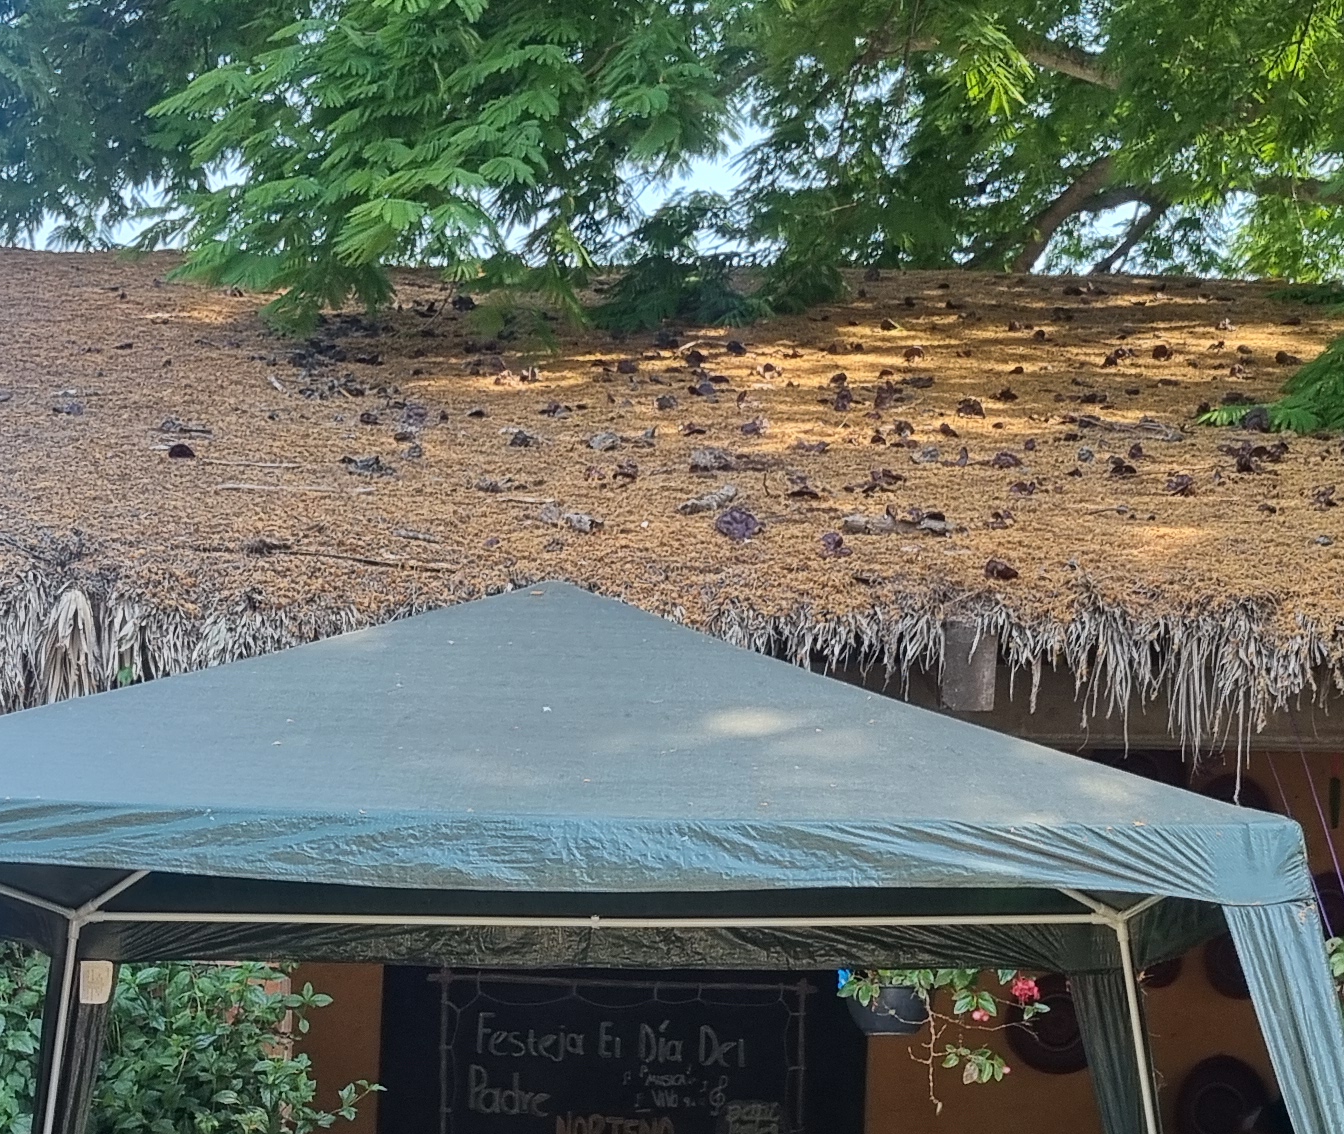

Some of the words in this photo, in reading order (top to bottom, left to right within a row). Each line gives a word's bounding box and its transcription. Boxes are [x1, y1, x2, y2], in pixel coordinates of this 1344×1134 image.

[476, 1011, 585, 1062] Festeja
[639, 1019, 684, 1064] Día
[467, 1063, 552, 1118] Padre
